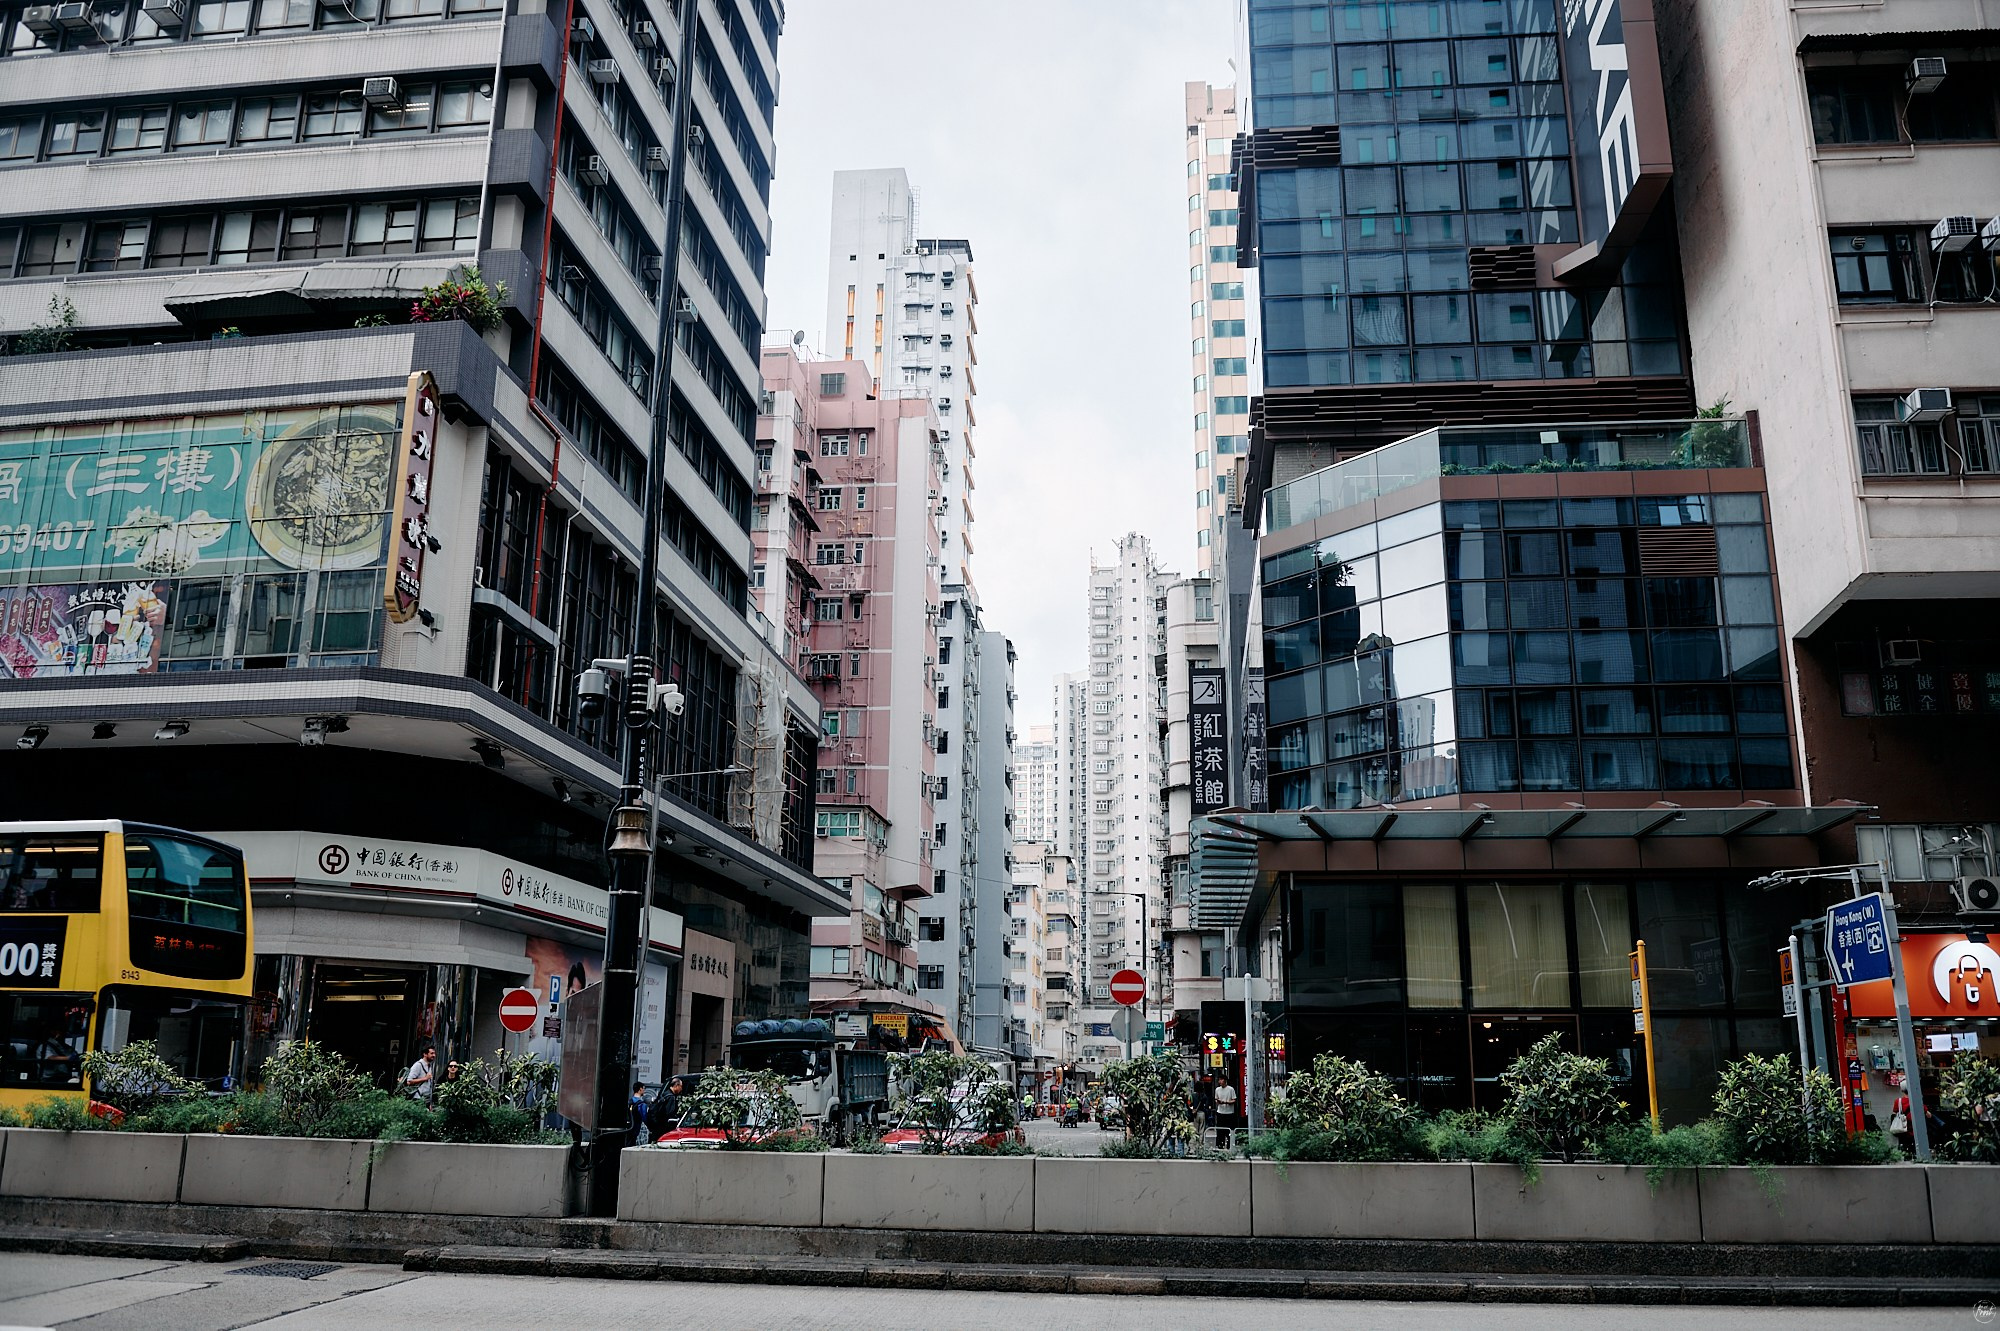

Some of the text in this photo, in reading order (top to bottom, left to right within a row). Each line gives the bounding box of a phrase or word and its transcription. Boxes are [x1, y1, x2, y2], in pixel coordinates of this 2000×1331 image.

[1193, 714, 1204, 804] BRIDAL TEA HOUSE
[1203, 713, 1224, 804] 紅茶館
[355, 869, 422, 882] BANK OF CHINA
[567, 895, 584, 914] BANK
[586, 903, 595, 915] OF
[1835, 904, 1875, 926] Hong Kong (W)
[1838, 927, 1865, 948] 香港(西)
[121, 969, 141, 981] 8143
[552, 978, 559, 999] P
